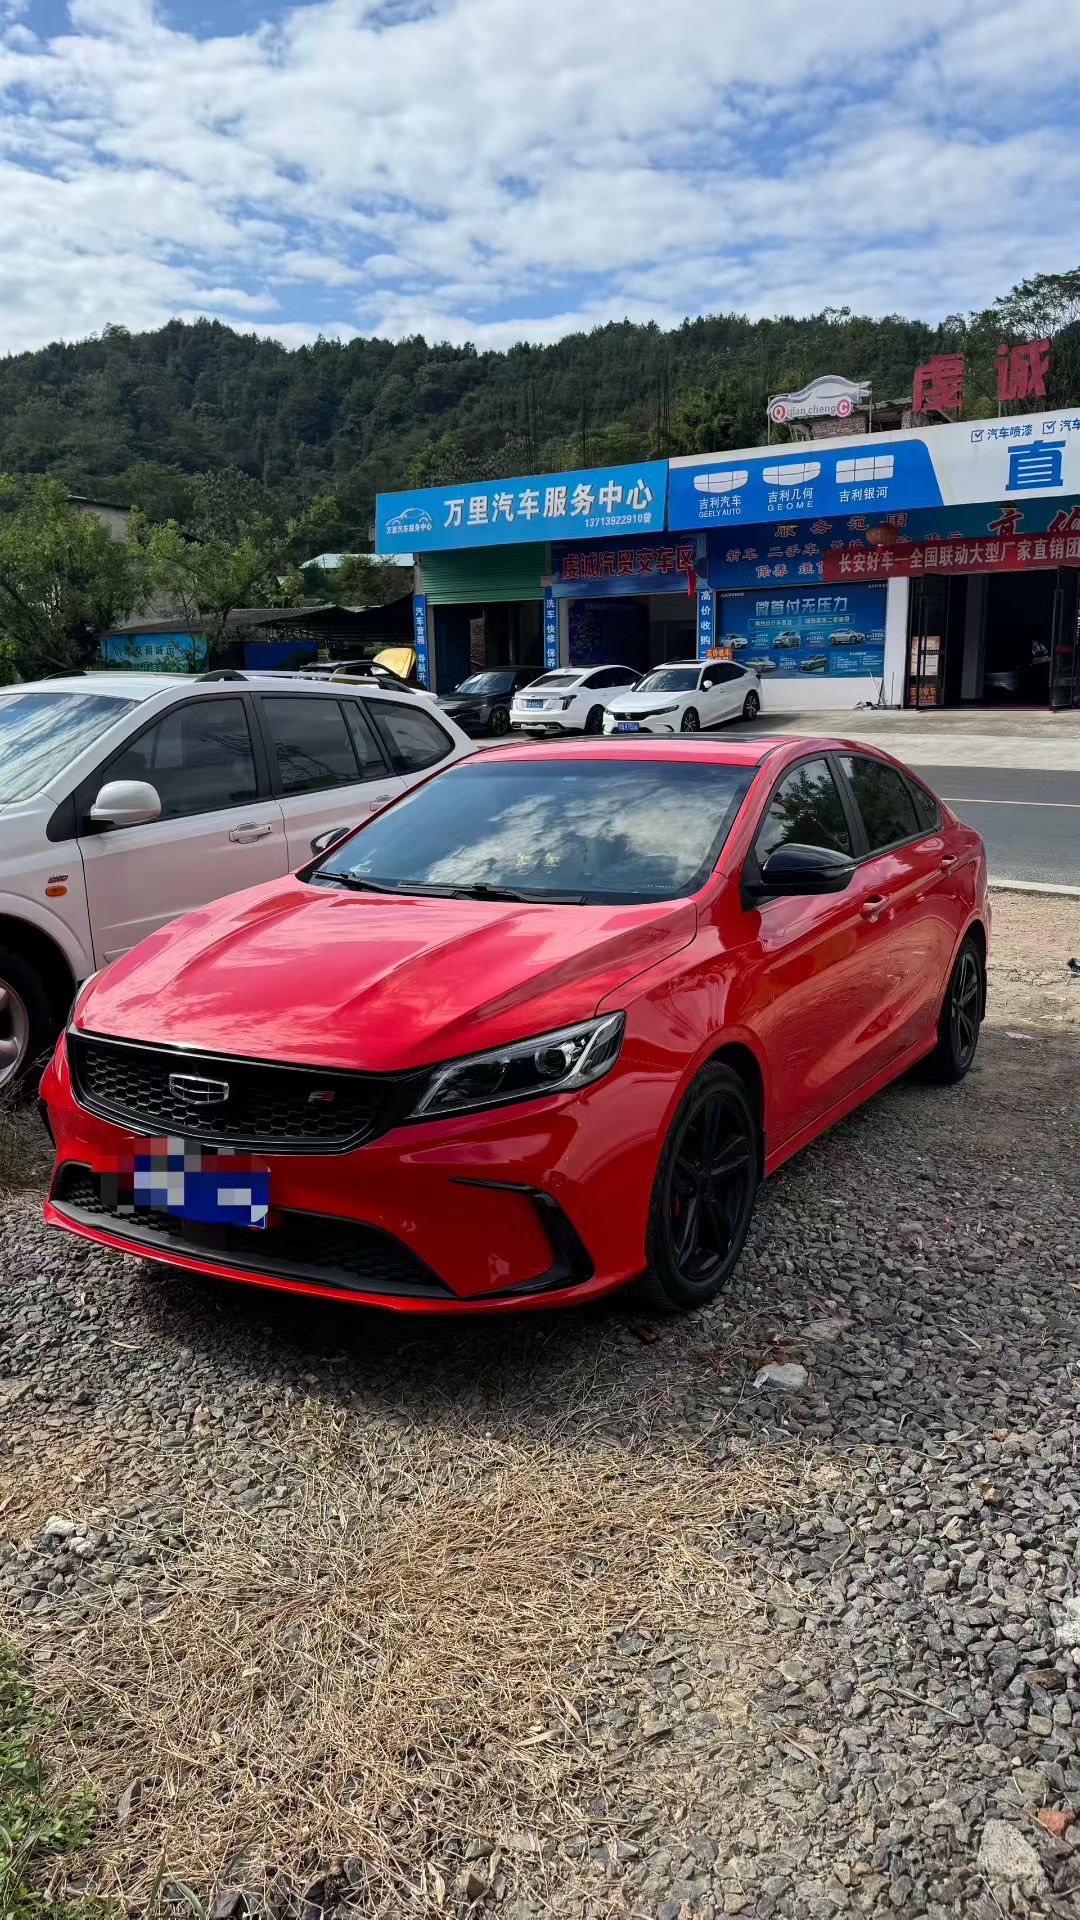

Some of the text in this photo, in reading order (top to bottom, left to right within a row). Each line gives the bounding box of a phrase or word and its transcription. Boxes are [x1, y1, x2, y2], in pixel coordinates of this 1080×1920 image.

[987, 424, 1033, 440] 汽车喷漆
[1005, 440, 1066, 491] 直
[699, 494, 742, 510] 吉利汽车
[768, 487, 814, 504] 吉利几何
[839, 486, 889, 503] 吉利银河
[443, 479, 653, 528] 万里汽车服务中心
[767, 501, 814, 512] GEOME
[698, 507, 741, 518] GEELY AUTO
[726, 547, 758, 563] 新车
[767, 542, 819, 558] 二手车
[546, 599, 556, 619] 洗车
[755, 596, 848, 617] 微首付无压力
